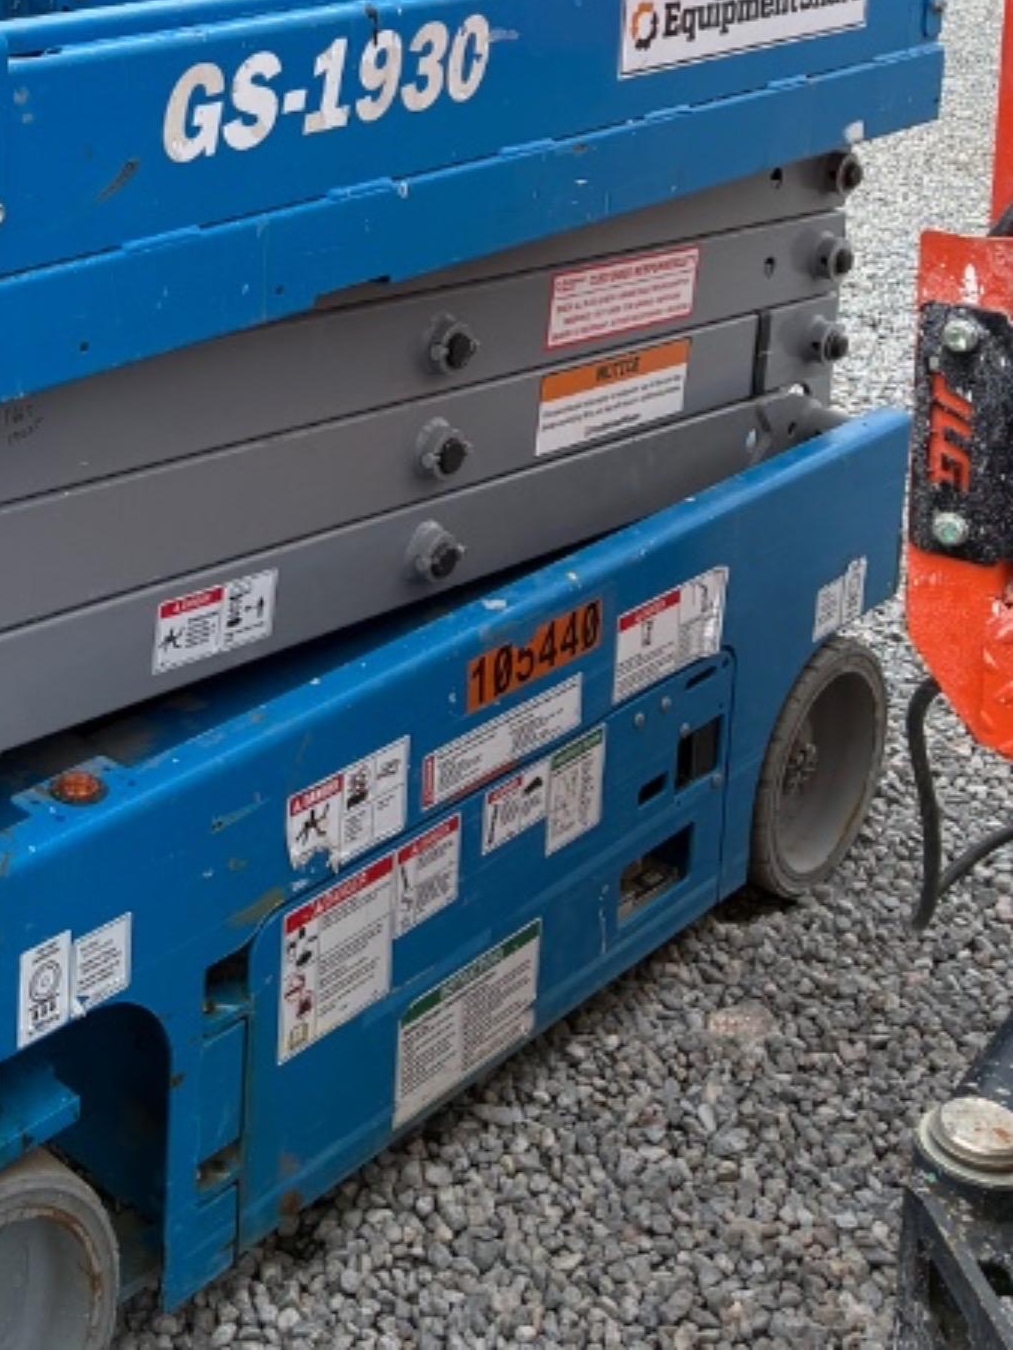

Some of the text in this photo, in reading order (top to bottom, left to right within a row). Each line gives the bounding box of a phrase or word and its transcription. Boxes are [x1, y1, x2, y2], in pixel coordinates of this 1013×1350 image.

[162, 12, 491, 165] GS-1930
[926, 369, 974, 495] JLG
[471, 599, 601, 705] 105440
